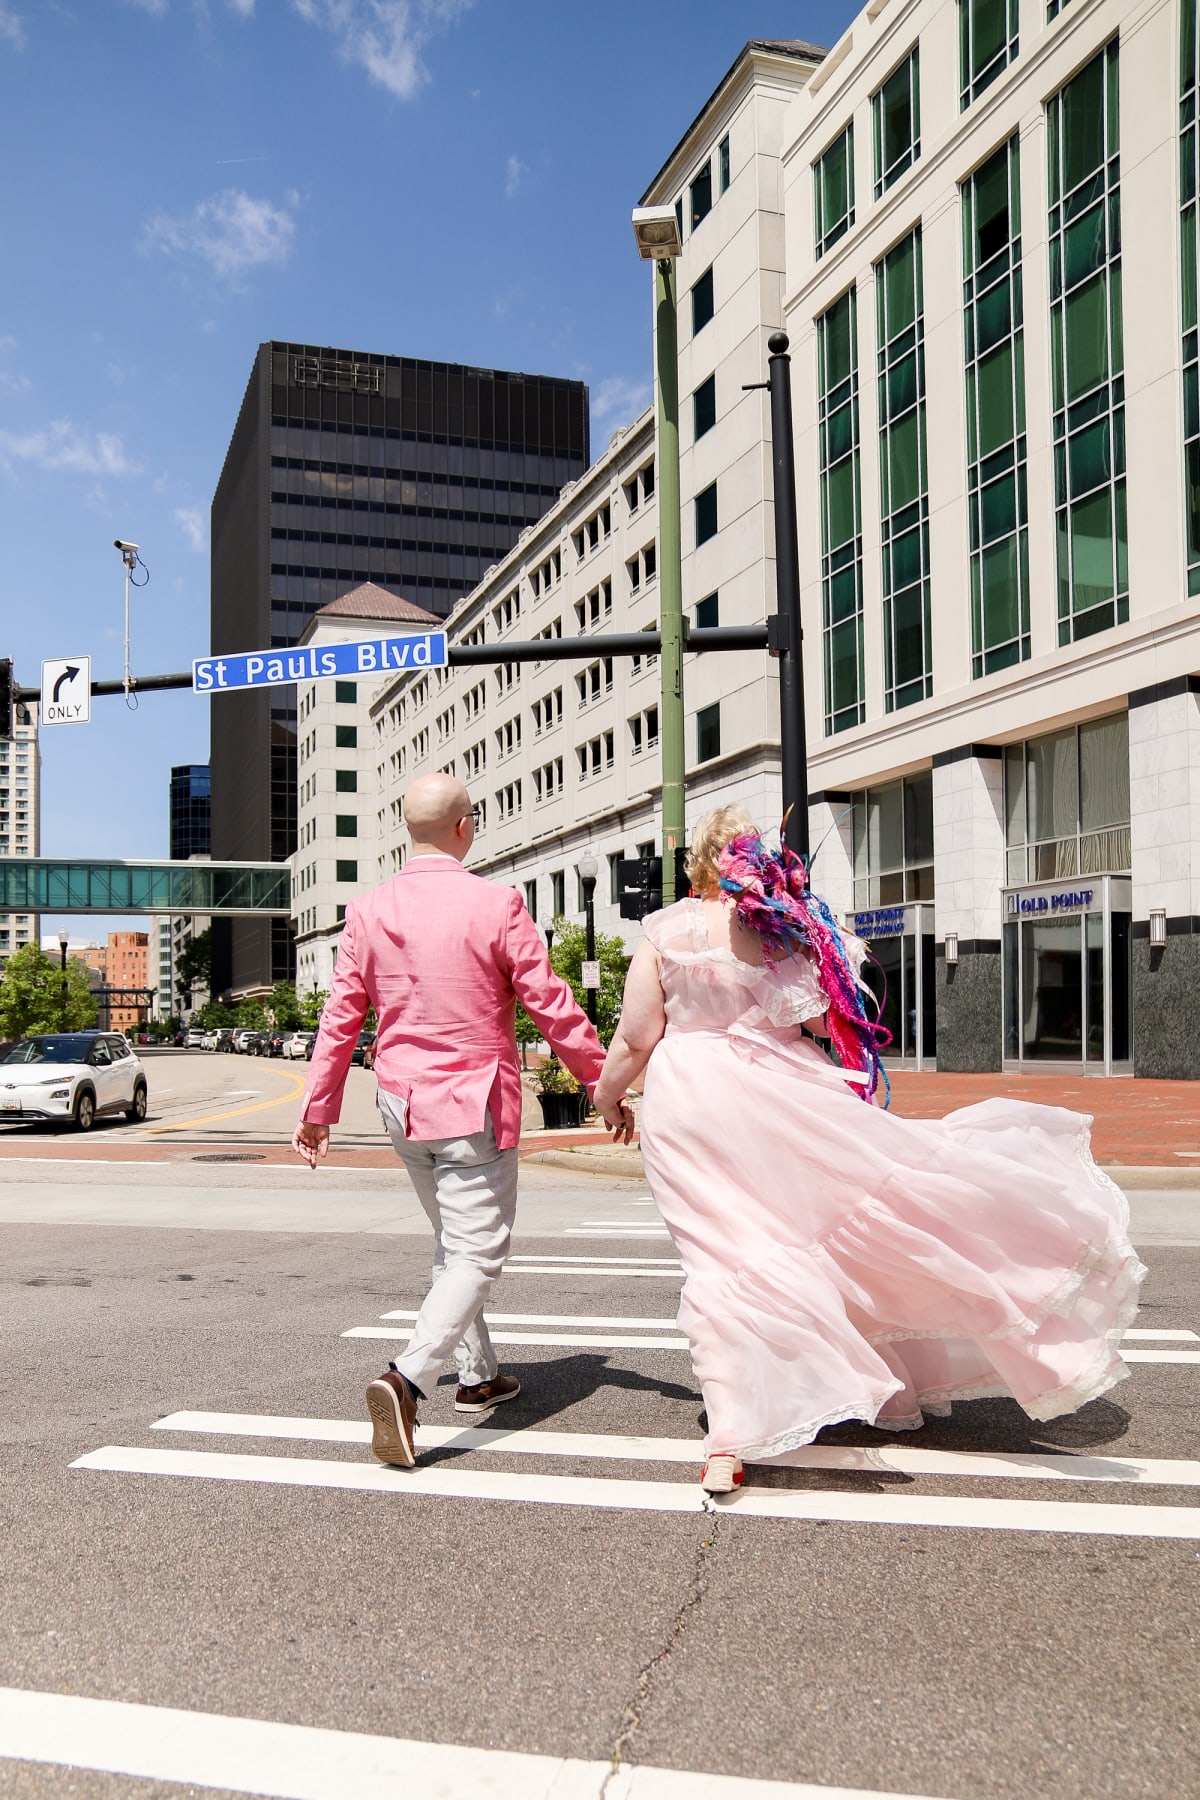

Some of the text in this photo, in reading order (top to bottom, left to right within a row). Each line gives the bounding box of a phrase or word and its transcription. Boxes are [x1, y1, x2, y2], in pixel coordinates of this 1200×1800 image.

[197, 636, 433, 689] St Pauls Blvd
[48, 704, 82, 719] ONLY
[1021, 890, 1094, 912] OLD POINT
